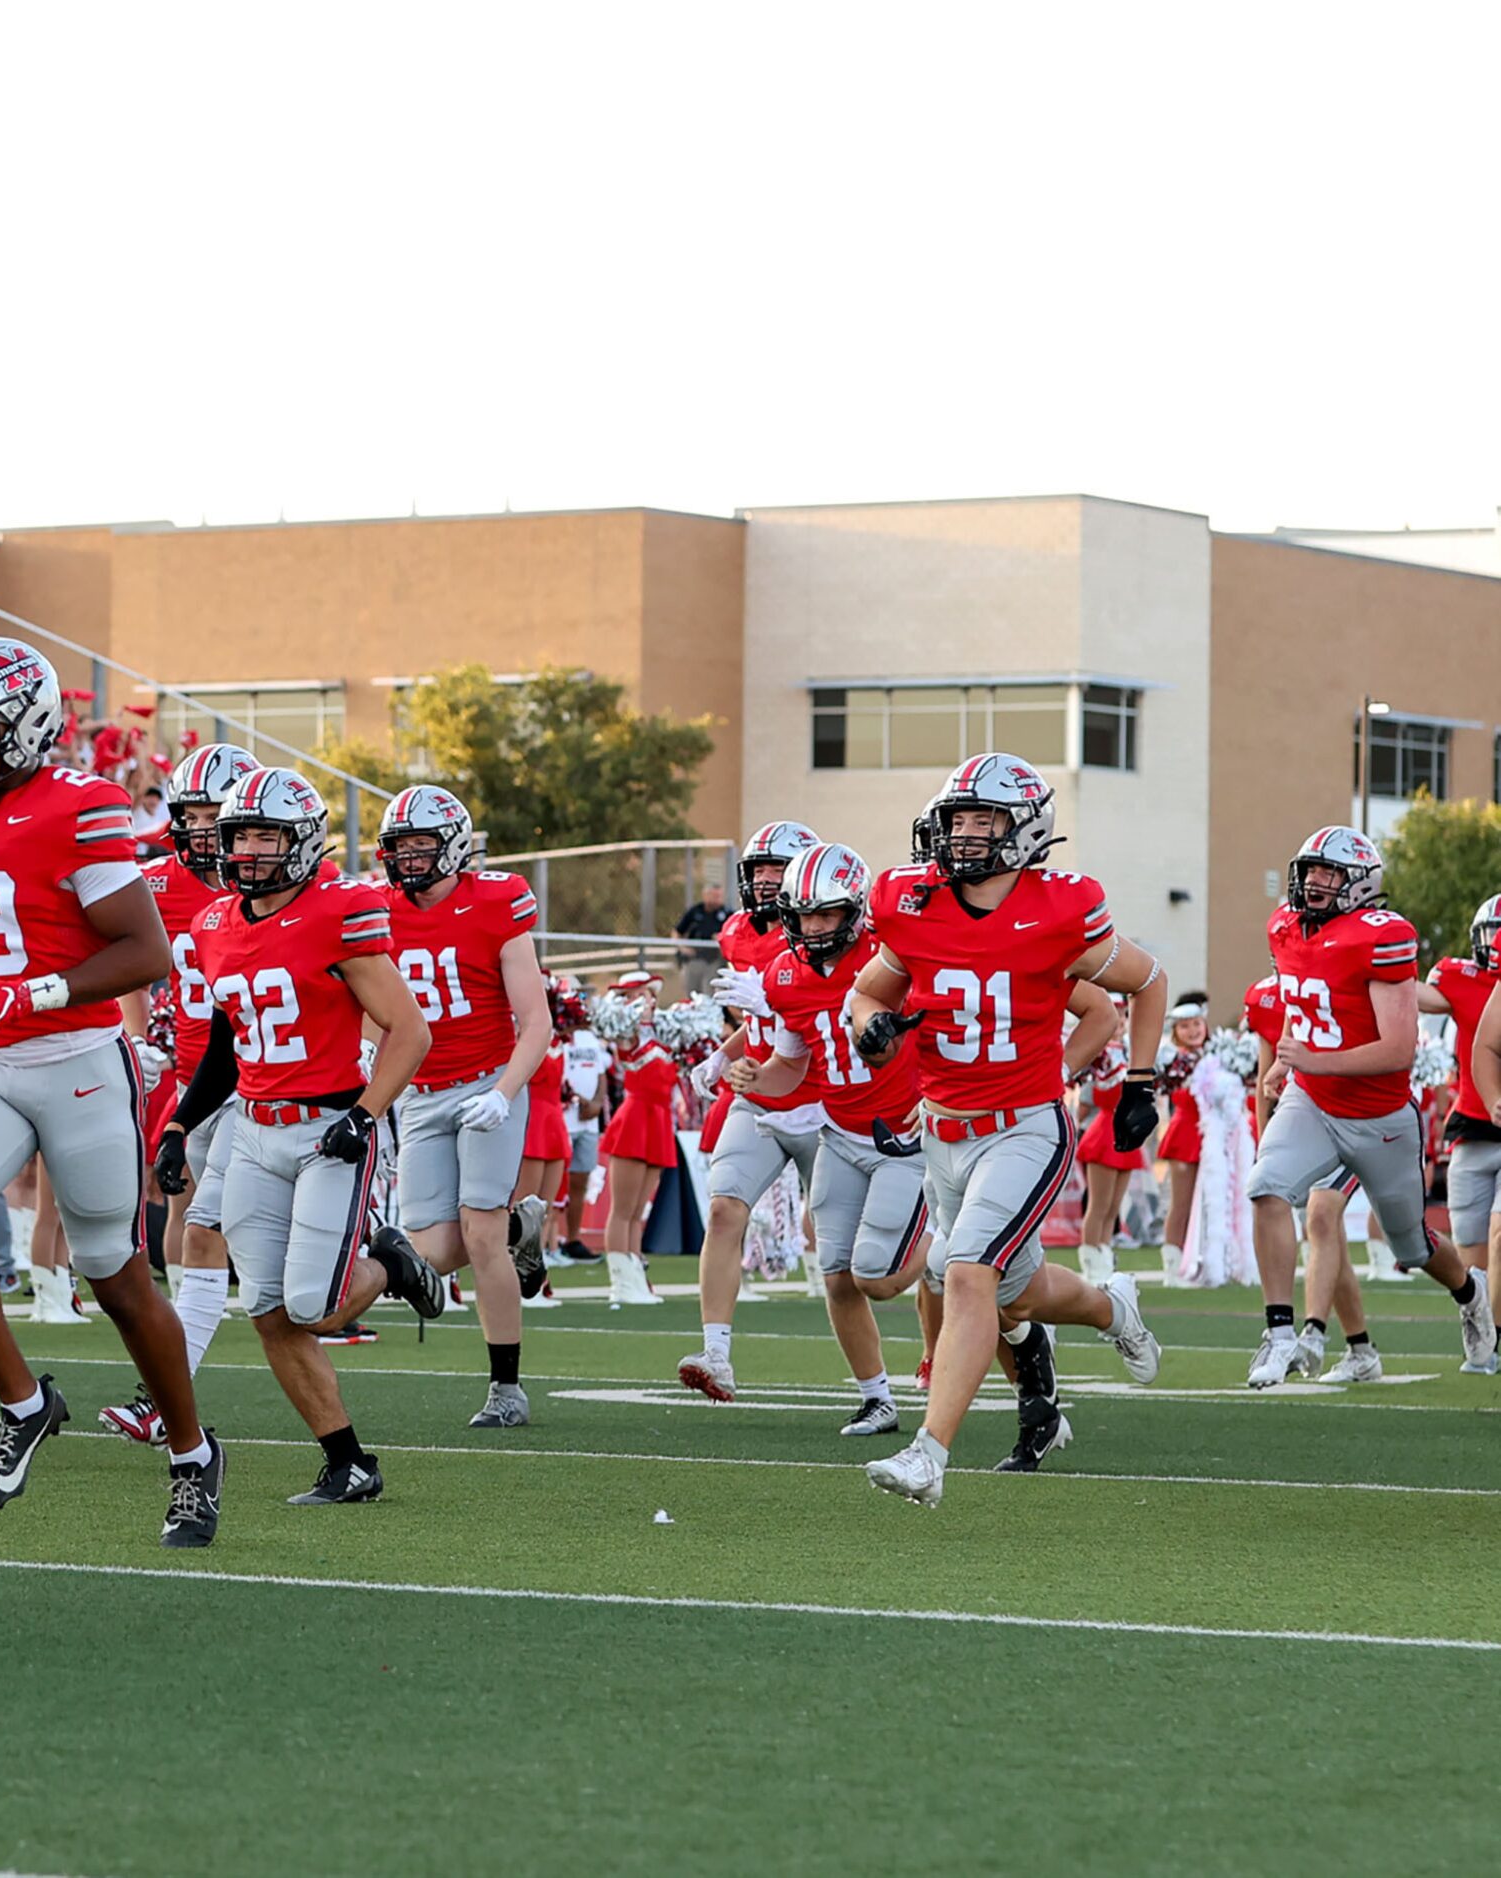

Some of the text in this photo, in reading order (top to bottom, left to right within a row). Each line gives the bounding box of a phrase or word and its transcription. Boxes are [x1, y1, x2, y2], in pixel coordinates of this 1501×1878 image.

[211, 967, 307, 1064] 32
[398, 947, 472, 1022] 81
[933, 968, 1018, 1064] 31
[814, 1010, 872, 1086] 11
